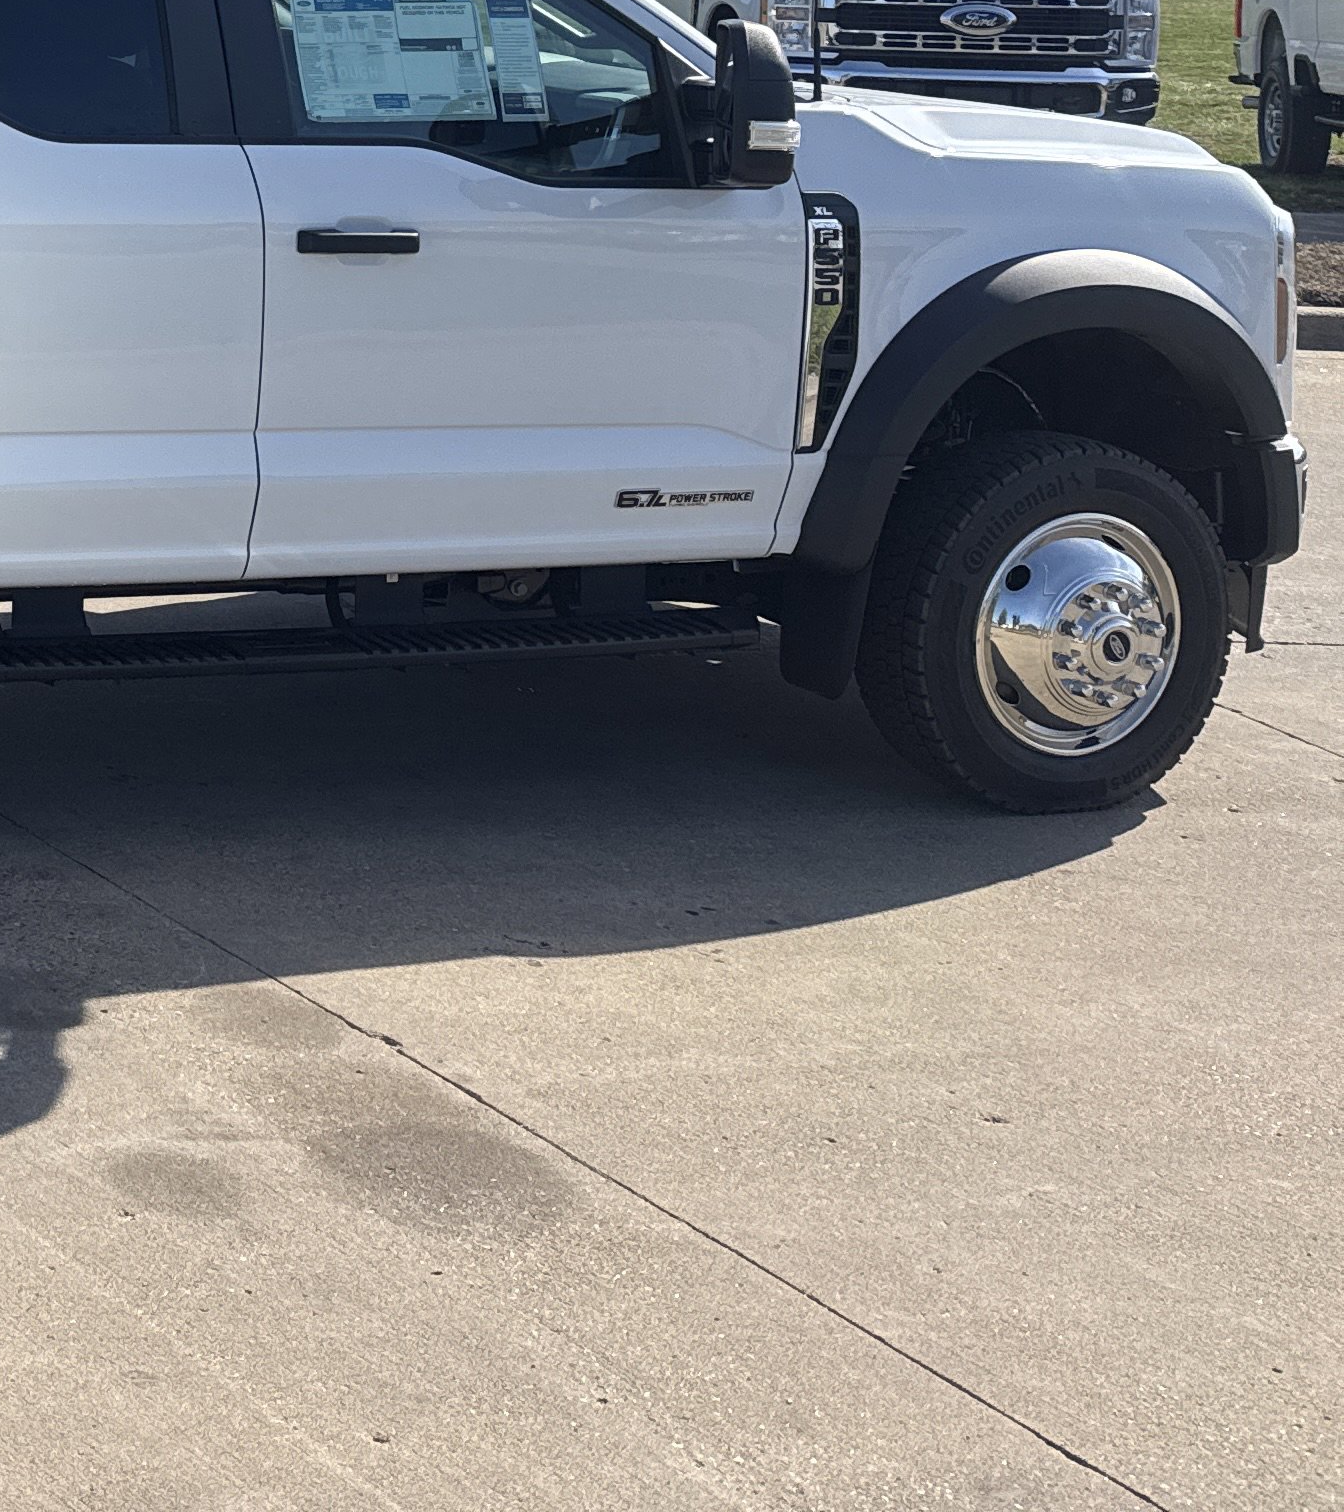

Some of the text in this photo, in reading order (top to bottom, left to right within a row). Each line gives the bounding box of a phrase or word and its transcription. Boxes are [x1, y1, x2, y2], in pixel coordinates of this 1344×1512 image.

[962, 12, 998, 27] Ford
[813, 206, 833, 216] XL
[814, 228, 842, 306] F550
[617, 490, 752, 508] 6.7L POWER STROKE
[966, 473, 1065, 574] Continental
